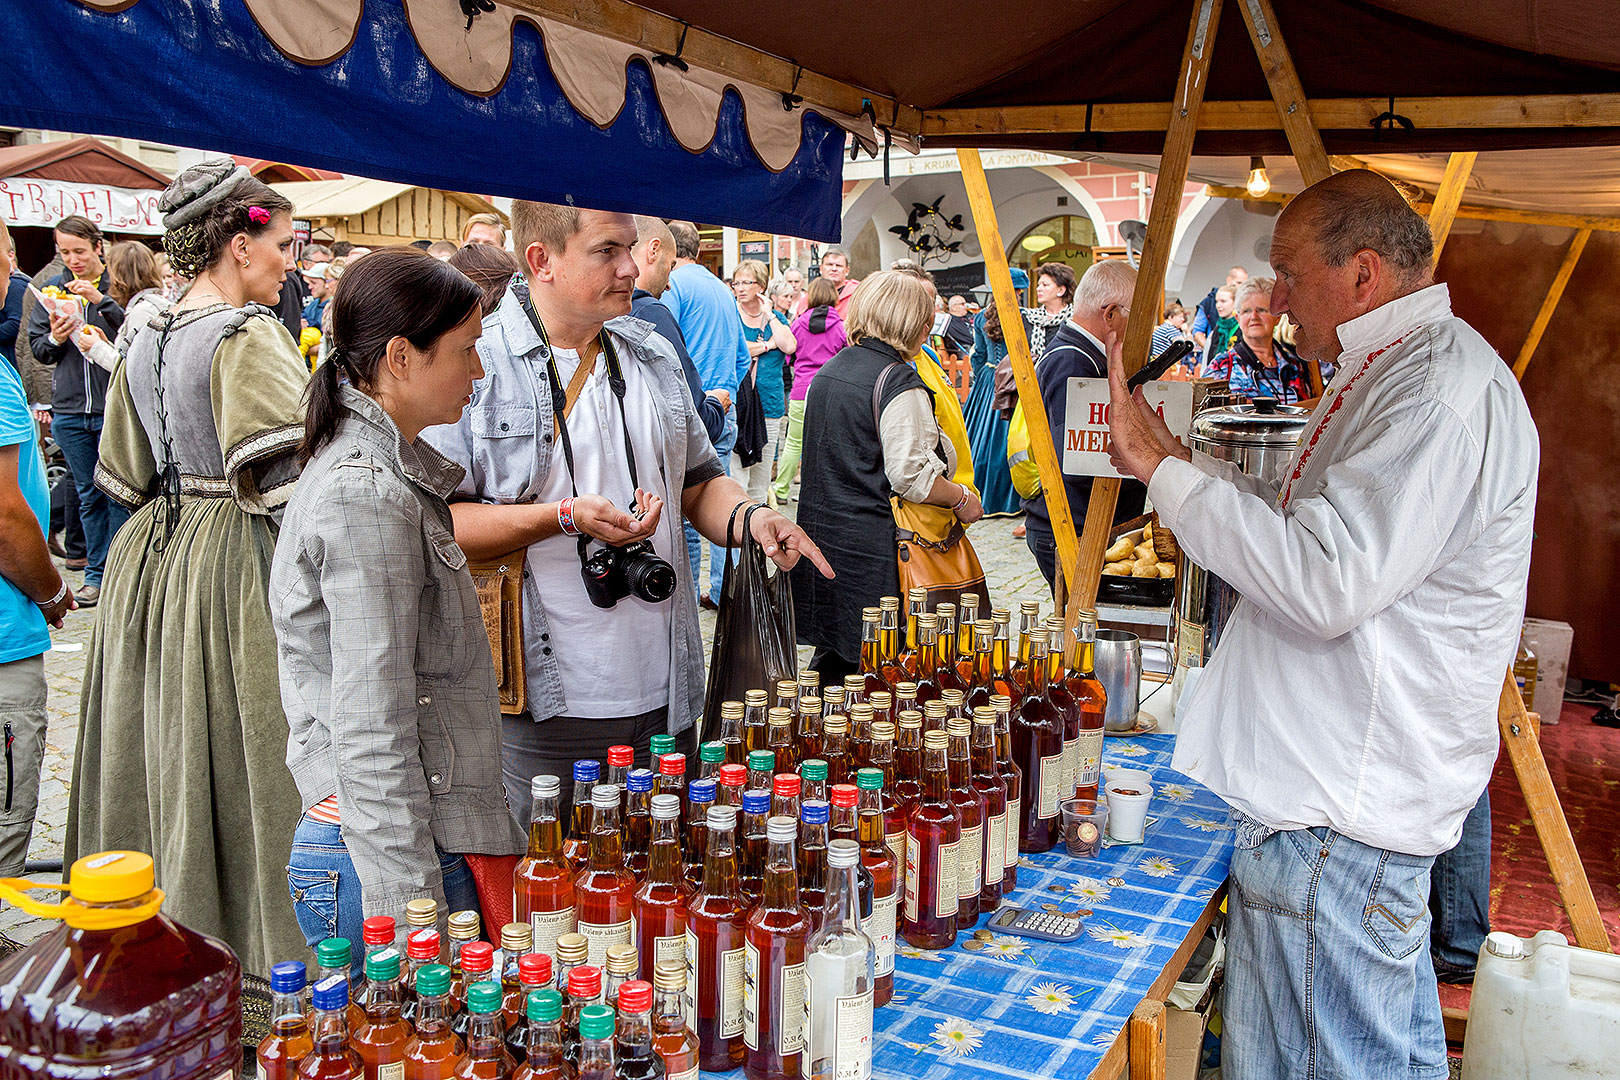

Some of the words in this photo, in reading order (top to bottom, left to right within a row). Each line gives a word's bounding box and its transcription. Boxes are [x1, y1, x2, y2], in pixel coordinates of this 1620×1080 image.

[924, 156, 995, 170] KRUMLKA
[998, 152, 1048, 165] FONTANA
[0, 181, 158, 227] TRDELN
[626, 543, 642, 554] Nikon
